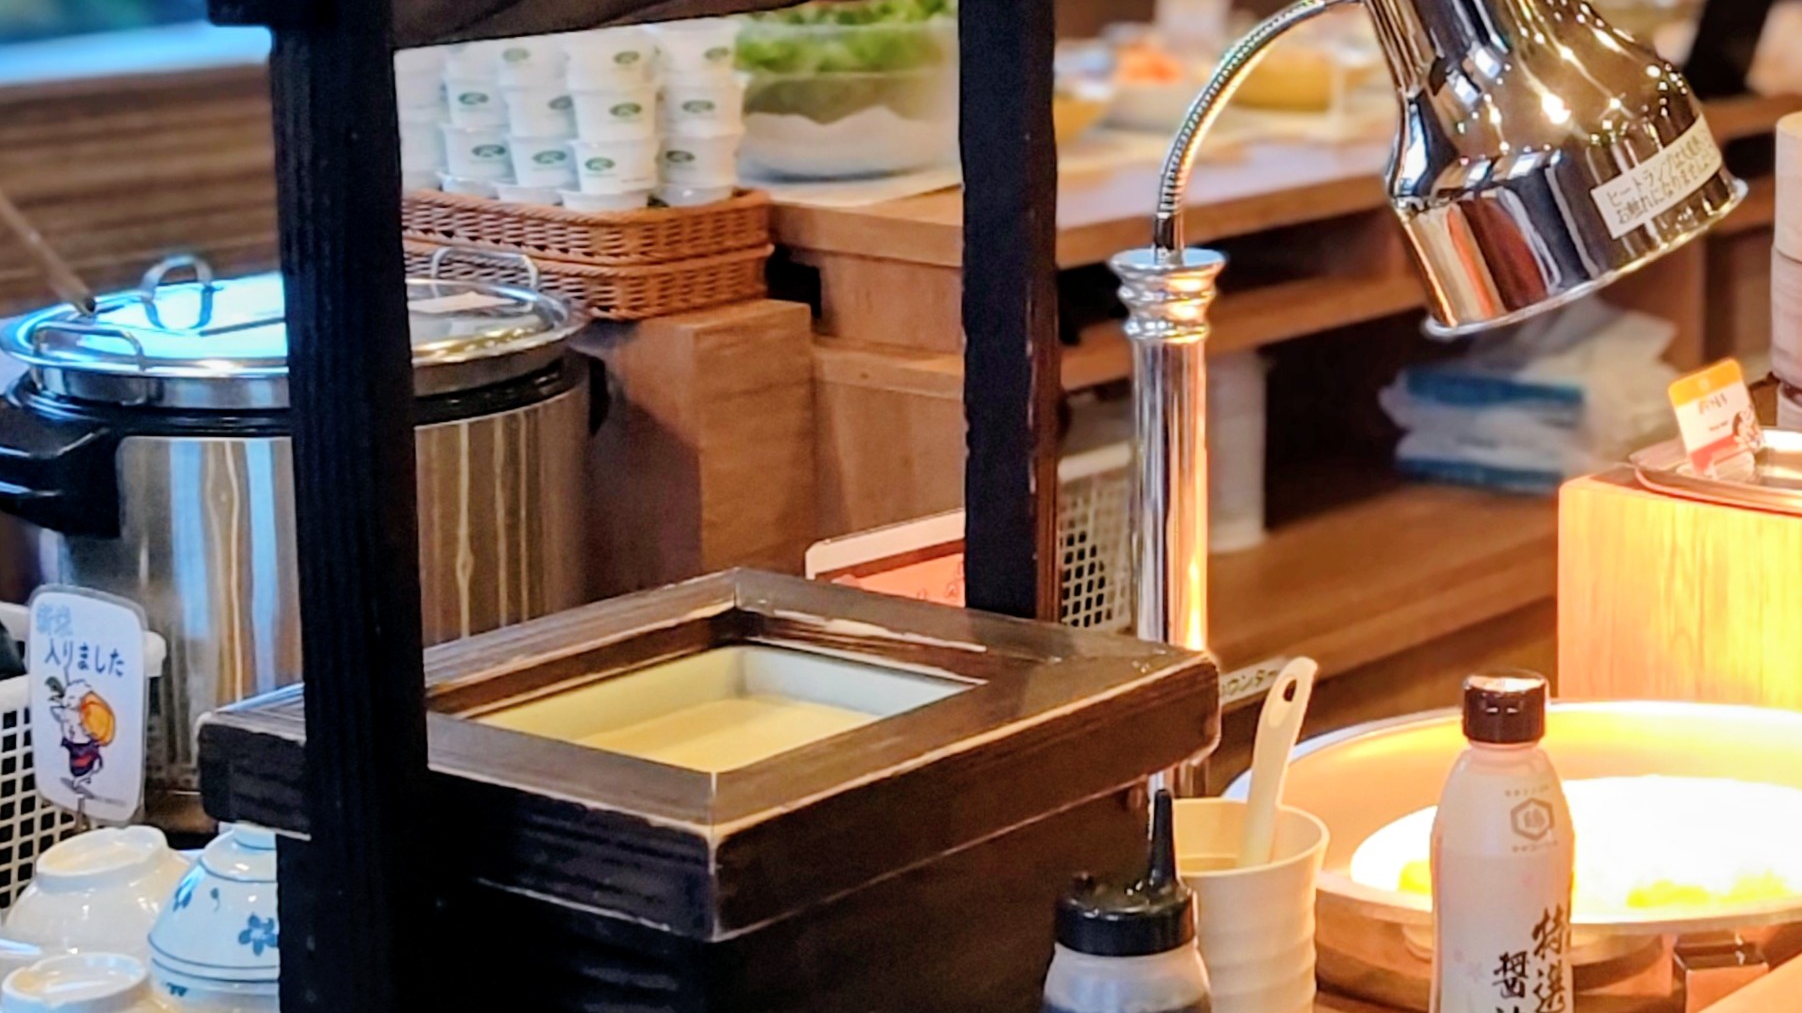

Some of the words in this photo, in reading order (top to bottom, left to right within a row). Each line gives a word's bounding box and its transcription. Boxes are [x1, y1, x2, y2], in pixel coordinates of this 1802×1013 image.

[44, 638, 125, 677] 入りました
[1491, 950, 1530, 1013] 醤
